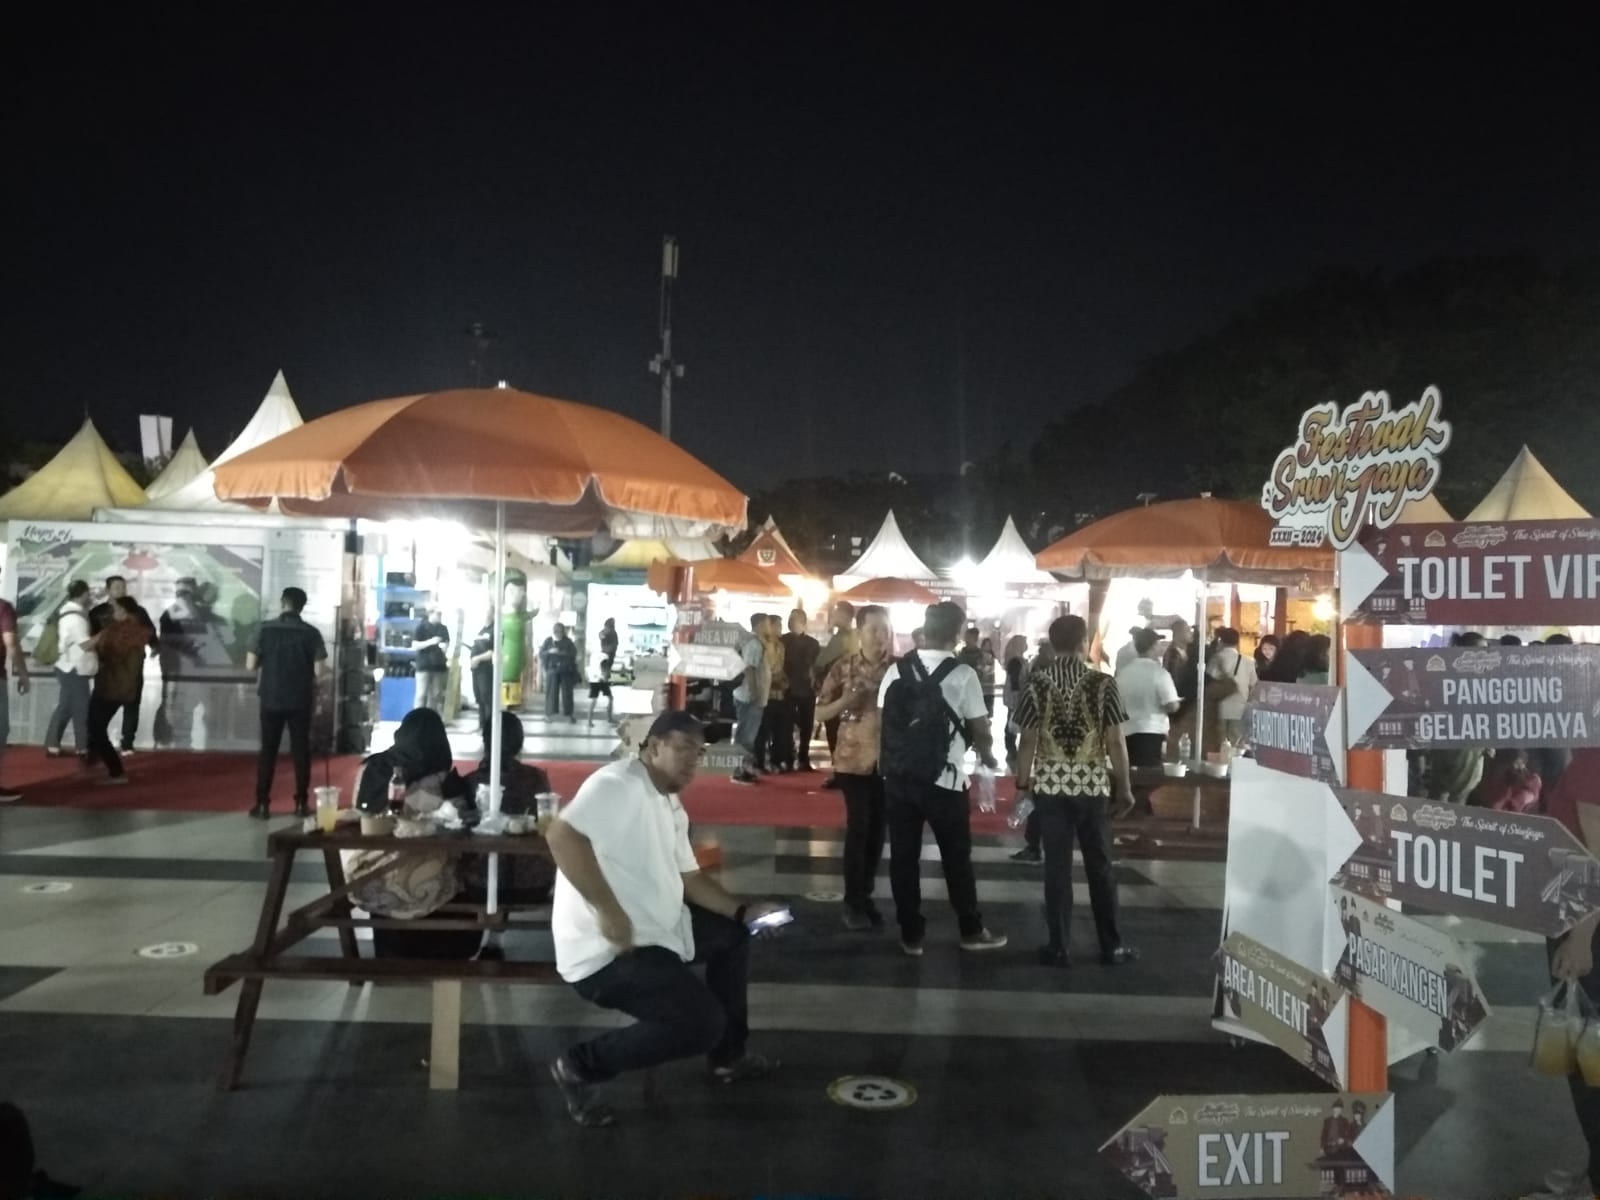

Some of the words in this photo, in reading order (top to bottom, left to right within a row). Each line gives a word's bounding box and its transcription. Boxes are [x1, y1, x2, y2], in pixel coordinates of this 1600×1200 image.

[1297, 394, 1446, 468] Festival
[1271, 457, 1435, 543] Sriwijaya
[1300, 529, 1323, 545] 2024
[1512, 529, 1529, 541] The
[1396, 555, 1533, 600] TOILET
[1442, 676, 1563, 705] PANGGUNG
[1290, 713, 1316, 756] EKRAF
[1419, 713, 1491, 741] GELAR
[1496, 711, 1588, 740] BUDAYA
[1460, 815, 1474, 828] The
[1474, 818, 1499, 832] Spirit
[1499, 823, 1508, 836] of
[1391, 830, 1525, 908] TOILET
[1224, 955, 1256, 1003] AREA
[1258, 975, 1311, 1037] TALENT
[1348, 931, 1390, 986] PASAR
[1389, 953, 1448, 1018] KANGEN
[1198, 1131, 1290, 1187] EXIT
